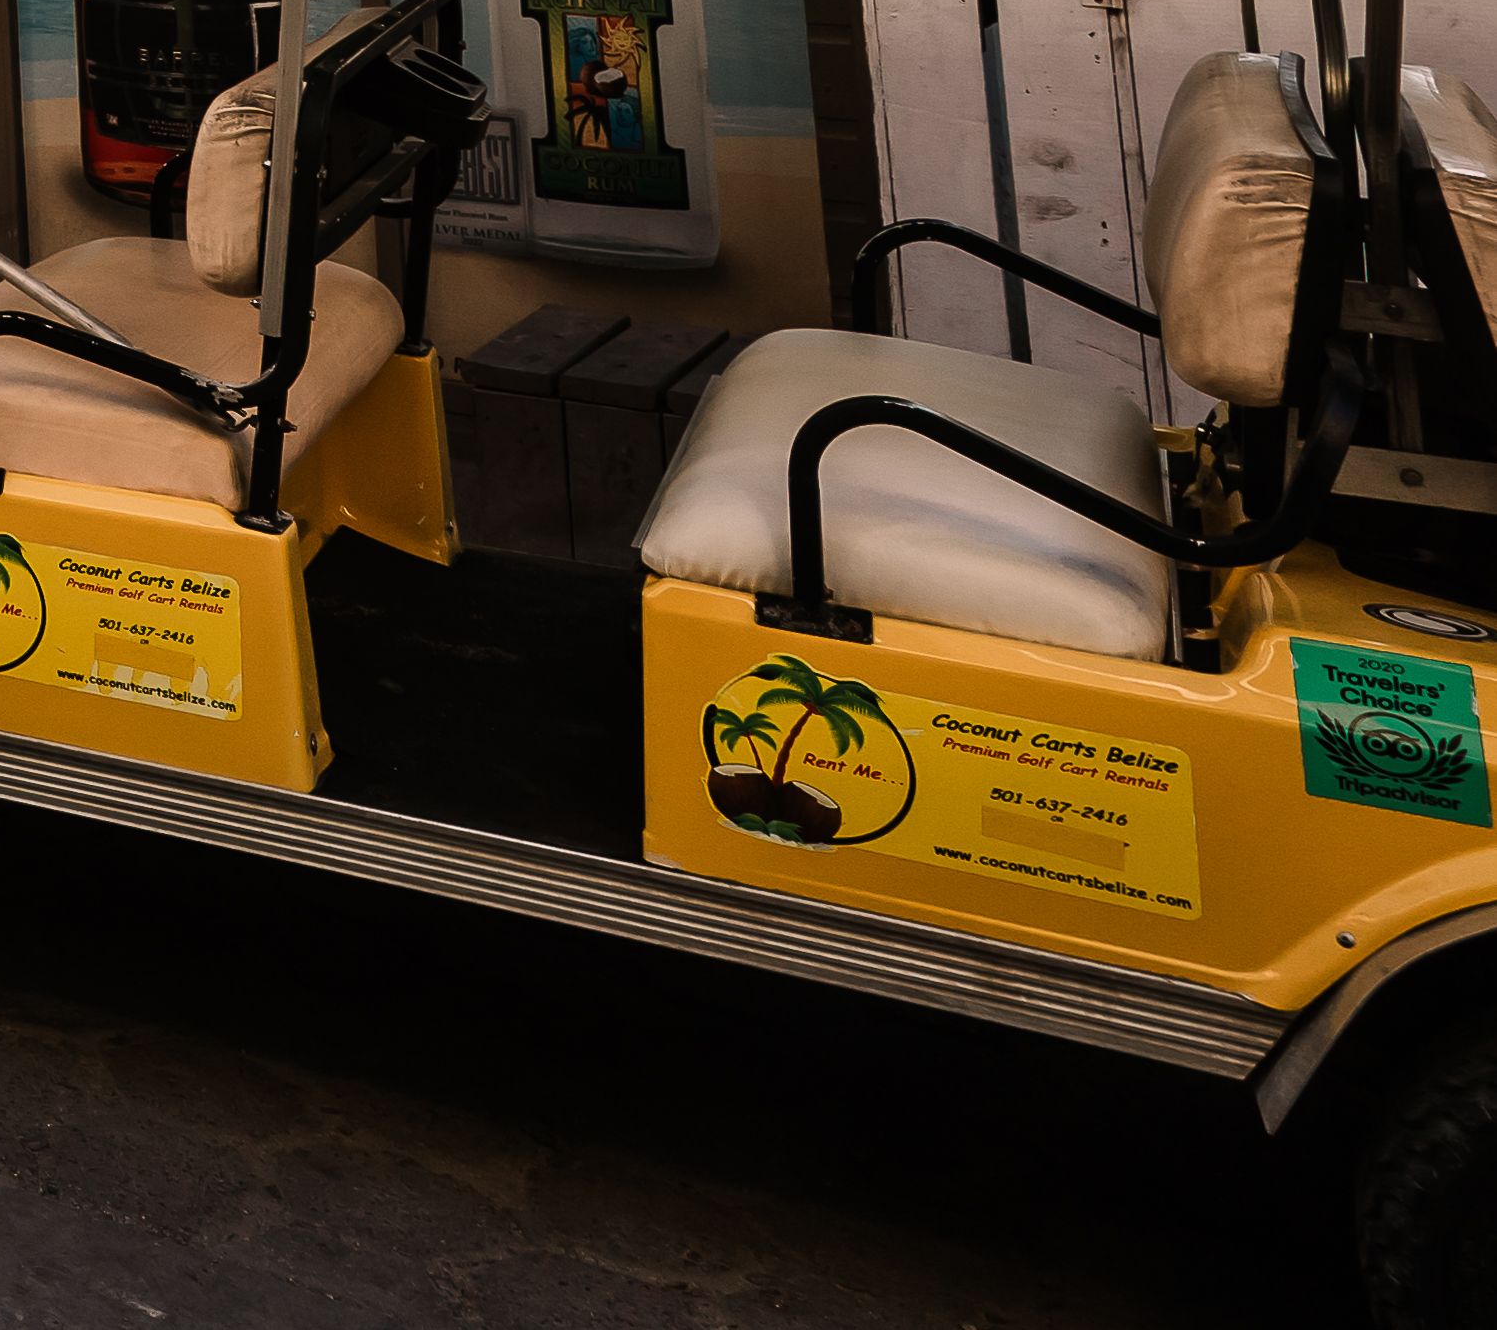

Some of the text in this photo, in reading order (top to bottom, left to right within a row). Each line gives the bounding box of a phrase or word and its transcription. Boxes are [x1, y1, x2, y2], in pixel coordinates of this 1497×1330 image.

[586, 175, 637, 192] RUM
[474, 227, 520, 240] MEDAL
[488, 213, 508, 221] Rum
[58, 557, 232, 600] Coconut Carts Belize
[65, 577, 225, 616] Premium Golf Cart Rentals
[1, 602, 39, 622] Me...
[97, 618, 196, 646] 501-637-2416
[1321, 663, 1446, 701] Travelers'
[1358, 657, 1406, 676] 2020
[56, 669, 237, 714] www.coconutcartsbelize.com
[1339, 686, 1434, 718] Choice
[931, 713, 1180, 775] Coconut Carts Belize
[802, 752, 906, 787] Rent Me...
[941, 737, 1170, 793] Premium Golf Cart Rentals
[989, 787, 1129, 828] 501-637-2416
[1333, 775, 1463, 812] Tripadvisor
[933, 844, 1193, 911] www.coconutcartsbelize.com
